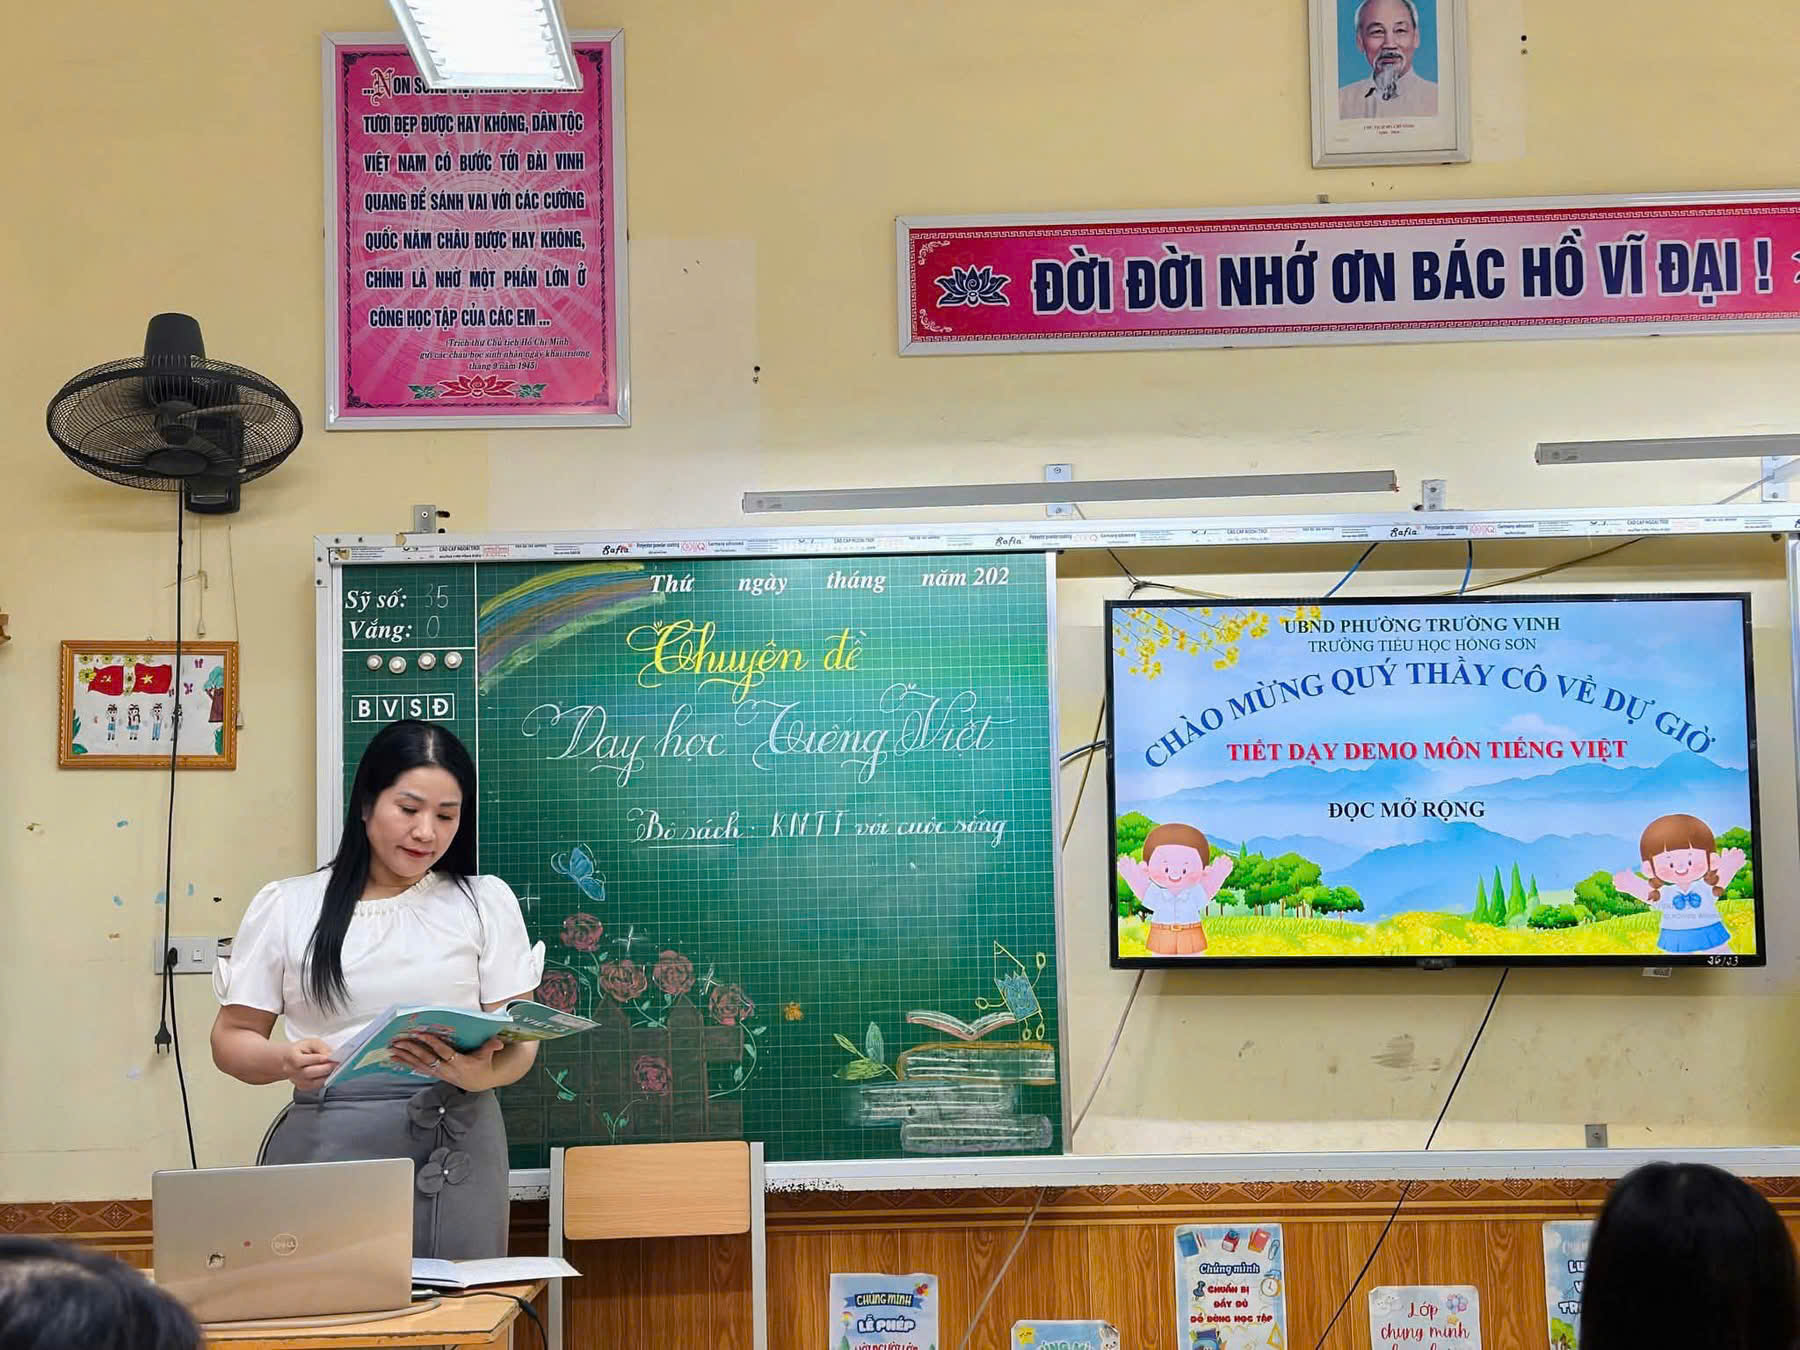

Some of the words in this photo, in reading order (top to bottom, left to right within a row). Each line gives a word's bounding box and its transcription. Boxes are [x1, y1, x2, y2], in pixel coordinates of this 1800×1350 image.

[363, 114, 391, 133] TƯƠI
[394, 116, 417, 136] ĐẸP
[421, 114, 453, 136] ĐƯỢC
[457, 115, 480, 132] HAY
[484, 112, 529, 134] KHÔNG,
[532, 111, 557, 131] DÂN
[560, 111, 583, 135] TỘC
[364, 152, 390, 174] VIỆT
[398, 154, 426, 171] NAM
[435, 150, 451, 171] CÓ
[460, 150, 492, 171] BƯỚC
[500, 149, 519, 171] TỚI
[527, 150, 547, 170] ĐÀI
[556, 153, 584, 170] VINH
[365, 193, 406, 211] QUANG
[410, 187, 426, 210] ĐỂ
[431, 188, 464, 210] SÁNH
[468, 193, 487, 209] VAI
[491, 189, 512, 209] VỚI
[515, 189, 539, 209] CÁC
[543, 188, 584, 209] CƯỜNG
[365, 227, 398, 249] QUỐC
[403, 229, 431, 248] NĂM
[437, 229, 469, 249] CHÂU
[474, 231, 507, 252] ĐƯỢC
[512, 232, 535, 248] HAY
[540, 229, 585, 250] KHÔNG,
[366, 266, 403, 288] CHÍNH
[412, 267, 427, 287] LÀ
[435, 266, 460, 287] NHỜ
[470, 268, 496, 290] MỘT
[504, 265, 537, 287] PHẦN
[546, 265, 569, 286] LỚN
[577, 262, 586, 286] Ở
[1032, 247, 1111, 312] ĐỜI
[1126, 243, 1203, 309] ĐỜI
[1219, 240, 1318, 307] NHỚ
[1332, 248, 1396, 304] ƠN
[1412, 239, 1505, 300] BÁC
[1522, 228, 1583, 298] HỒ
[1600, 232, 1647, 295] VĨ
[1658, 240, 1737, 304] ĐẠI
[370, 306, 403, 326] CÔNG
[407, 309, 431, 329] HỌC
[435, 306, 457, 330] TẬP
[461, 303, 486, 326] CỦA
[489, 305, 513, 326] CÁC
[517, 309, 535, 325] EM
[492, 362, 498, 370] 9
[650, 574, 694, 593] Thứ
[738, 575, 788, 596] ngày
[826, 571, 886, 594] tháng
[921, 570, 968, 587] năm
[974, 567, 1010, 586] 202
[345, 589, 373, 613] Sỹ
[376, 588, 408, 608] số:
[349, 617, 413, 643] Vắng:
[1284, 619, 1334, 634] UBND
[1340, 615, 1421, 633] PHƯỜNG
[1426, 614, 1507, 632] TRƯỜNG
[1512, 617, 1560, 631] VINH
[1308, 638, 1374, 653] TRƯỜNG
[1418, 639, 1451, 653] HỌC
[1505, 637, 1537, 651] SƠN
[626, 618, 808, 703] Chuyên
[823, 627, 867, 671] đề
[358, 700, 371, 718] B
[382, 699, 399, 718] V
[410, 698, 422, 718] S
[431, 697, 449, 716] Đ
[1144, 707, 1224, 768] CHÀO
[1226, 673, 1324, 720] MỪNG
[1331, 657, 1397, 695] QUÝ
[1405, 656, 1495, 687] THẦY
[1501, 664, 1548, 693] CÔ
[1557, 674, 1598, 704] VỀ
[1602, 687, 1656, 724] DỰ
[1655, 711, 1716, 754] GIỜ
[654, 703, 727, 762] học
[735, 699, 888, 784] Tiếng
[880, 683, 1017, 758] Việt
[1226, 738, 1282, 761] TIẾT
[1287, 741, 1338, 765] DẠY
[1343, 741, 1417, 760] DEMO
[1423, 735, 1481, 760] MÔN
[1487, 735, 1564, 760] TIẾNG
[1570, 738, 1628, 763] VIỆT
[1328, 801, 1375, 822] ĐỌC
[1381, 796, 1417, 818] MỞ
[1422, 799, 1485, 821] RỘNG
[769, 810, 850, 839] KNTT
[1407, 1301, 1438, 1320] Lớp
